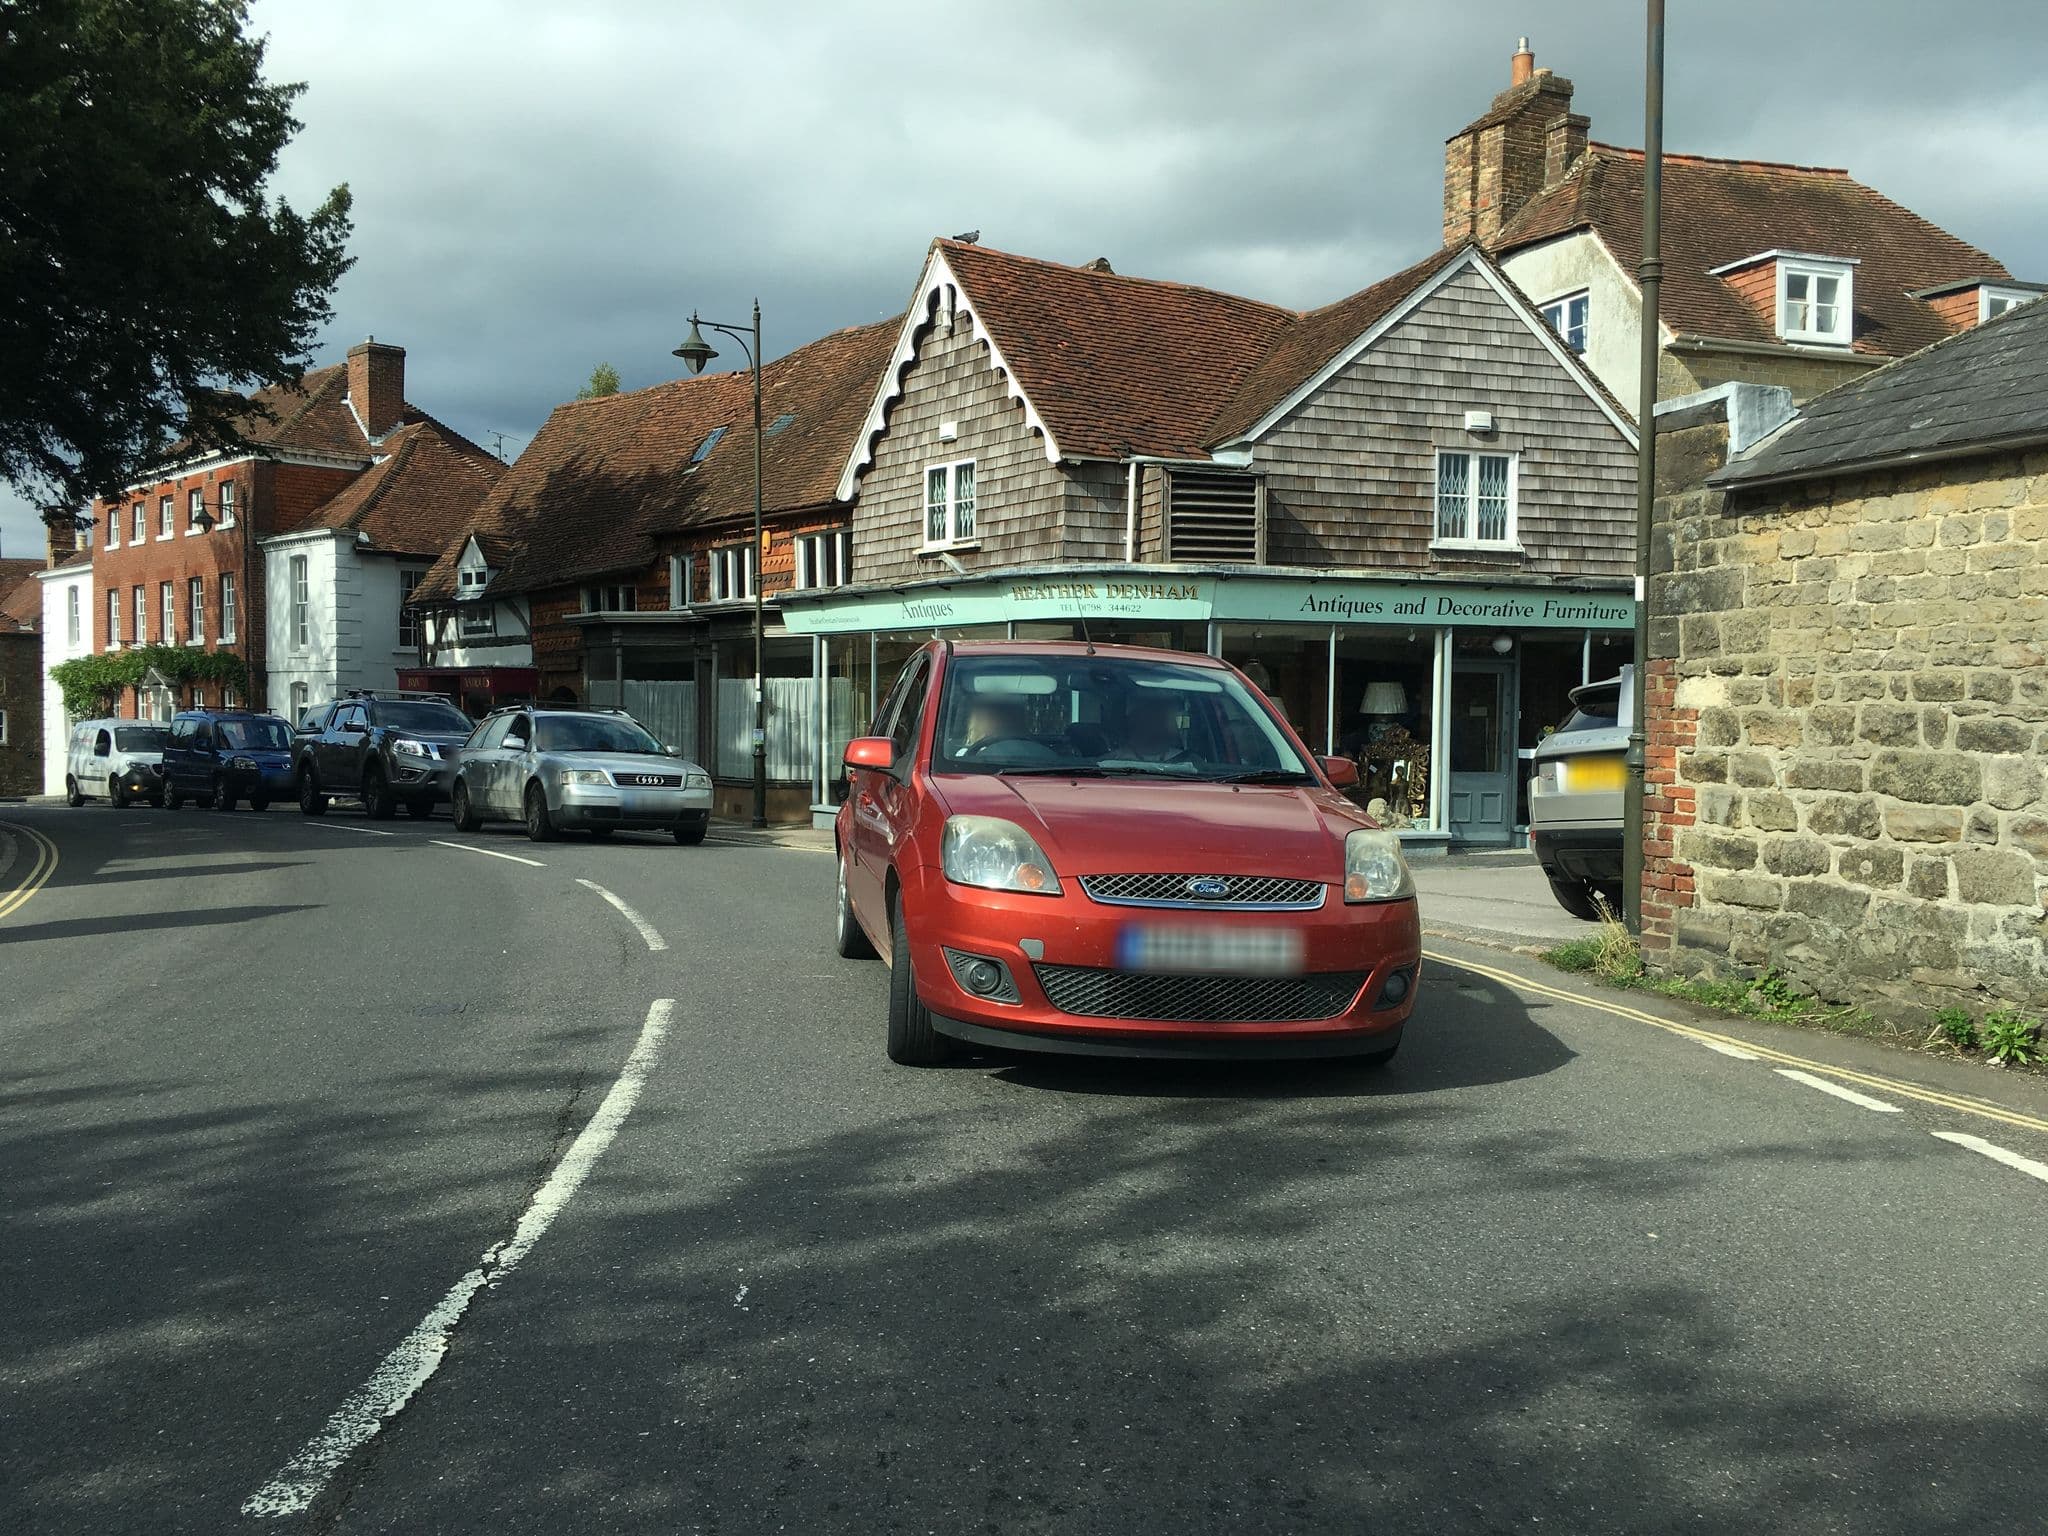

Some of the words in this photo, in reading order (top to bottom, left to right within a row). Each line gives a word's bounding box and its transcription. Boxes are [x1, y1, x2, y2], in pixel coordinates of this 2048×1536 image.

[1012, 583, 1099, 601] HEATHER
[1106, 583, 1200, 600] DENHAM
[902, 601, 953, 620] Antiques
[1109, 603, 1141, 613] 344622
[1300, 594, 1383, 618] Antiques
[1393, 597, 1427, 615] and
[1437, 597, 1534, 618] Decorative
[1543, 600, 1628, 620] Furniture
